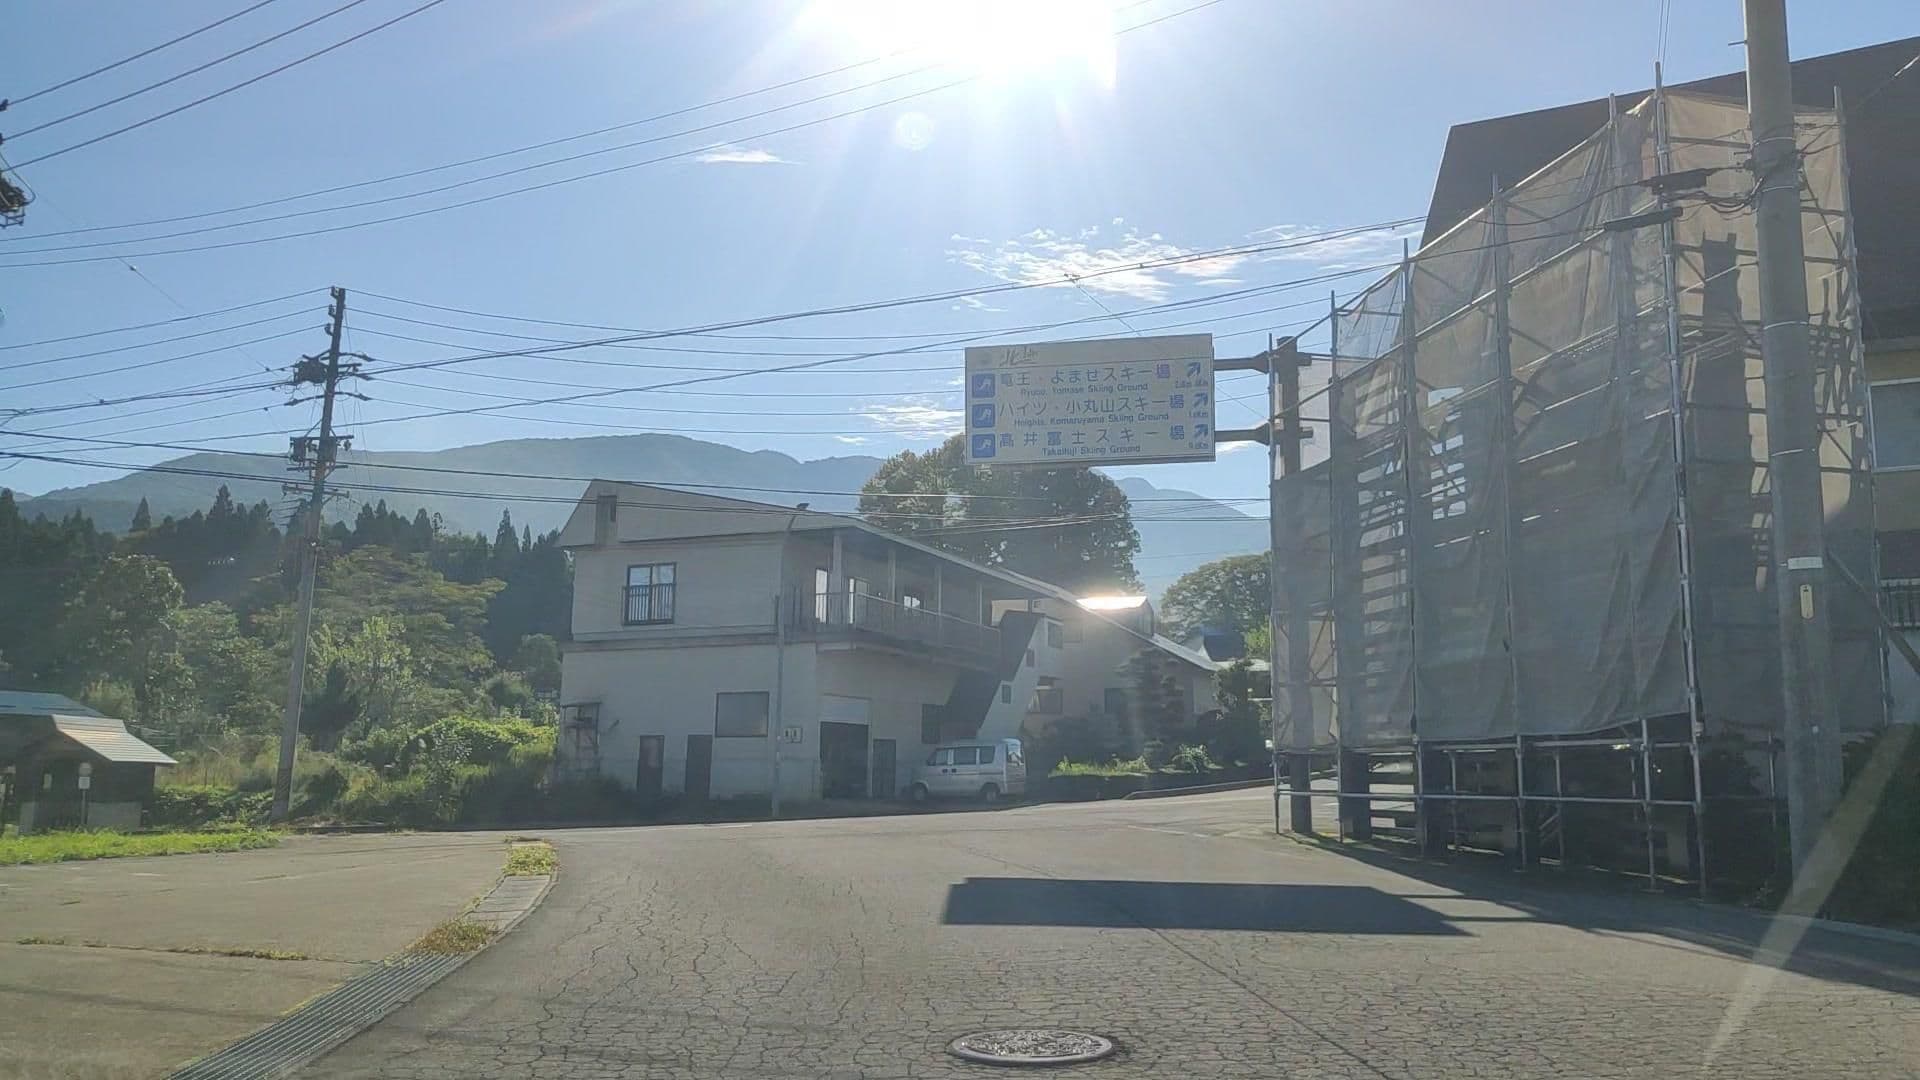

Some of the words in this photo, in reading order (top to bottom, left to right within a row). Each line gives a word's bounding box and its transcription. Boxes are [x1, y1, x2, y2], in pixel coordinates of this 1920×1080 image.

[1088, 383, 1113, 394] Skiing
[1117, 382, 1148, 392] Ground
[1108, 413, 1133, 424] Skiing
[1138, 412, 1169, 421] Ground
[1000, 424, 1185, 448] 高井富士スキー場
[1081, 445, 1106, 455] Skiing
[1110, 443, 1140, 453] Ground
